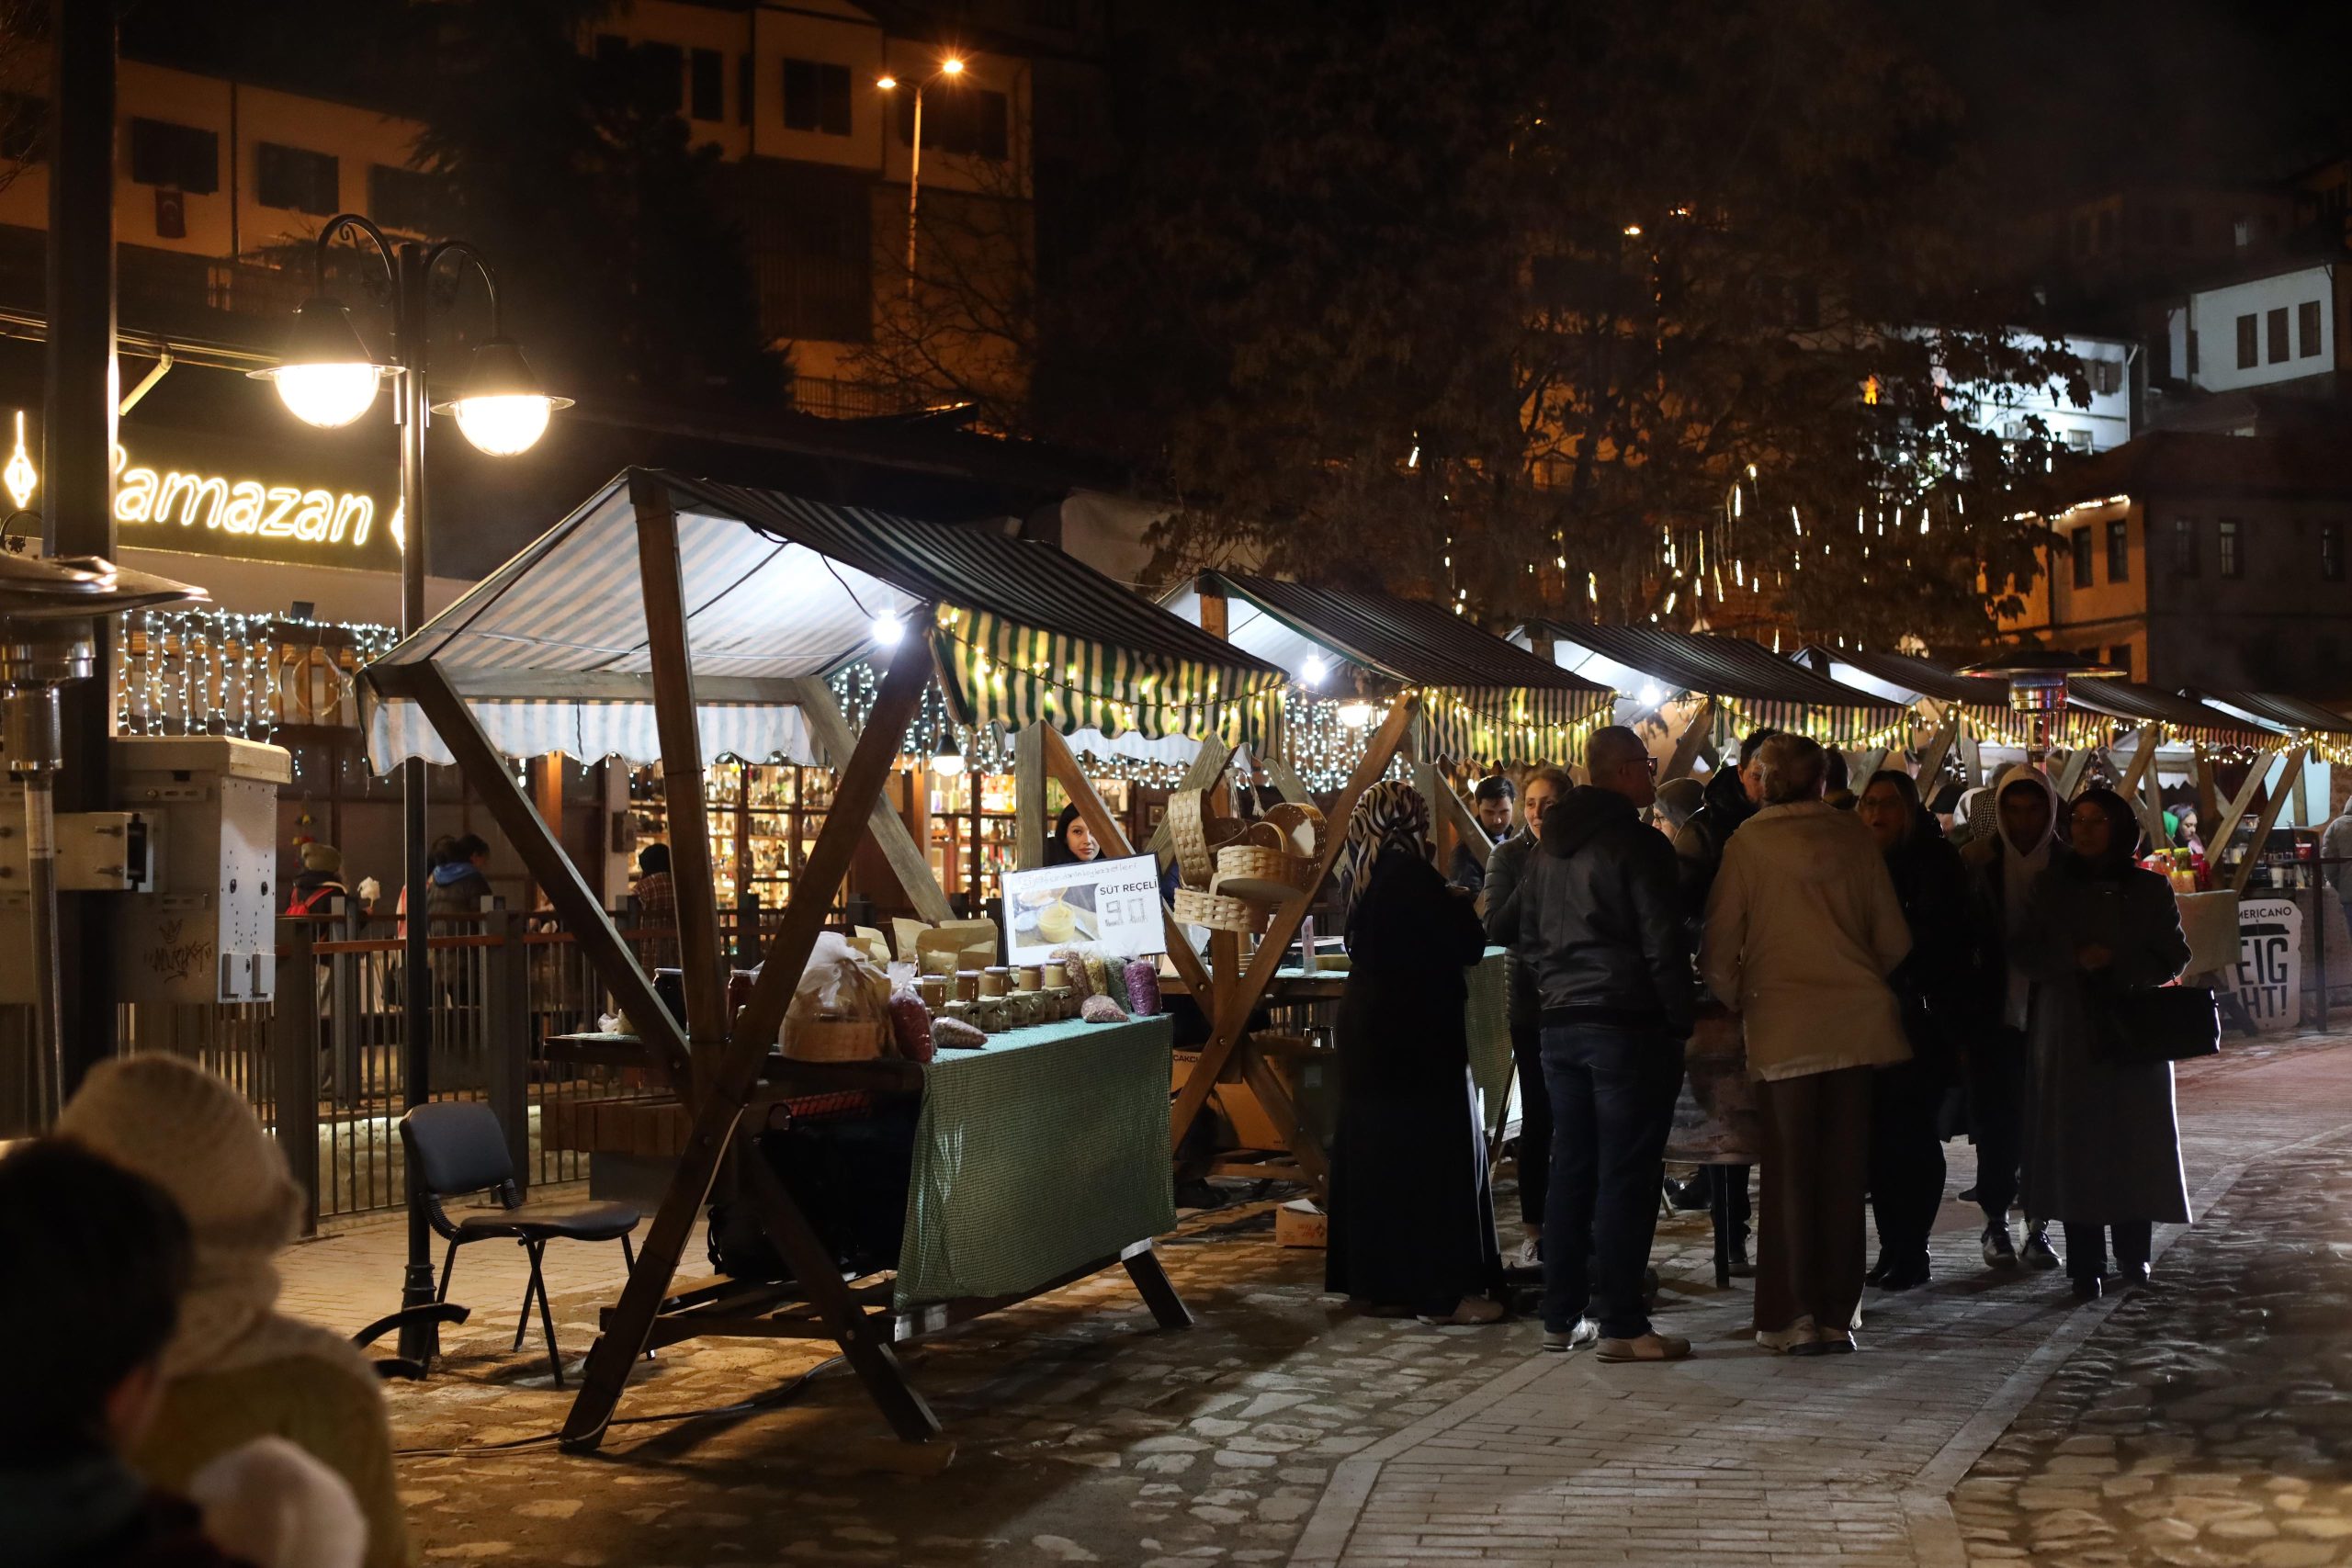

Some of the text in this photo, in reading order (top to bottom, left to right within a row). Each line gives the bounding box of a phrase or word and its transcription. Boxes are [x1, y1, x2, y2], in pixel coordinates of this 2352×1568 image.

[1100, 879, 1158, 896] SÜT REÇELİ
[2235, 937, 2289, 986] EIG
